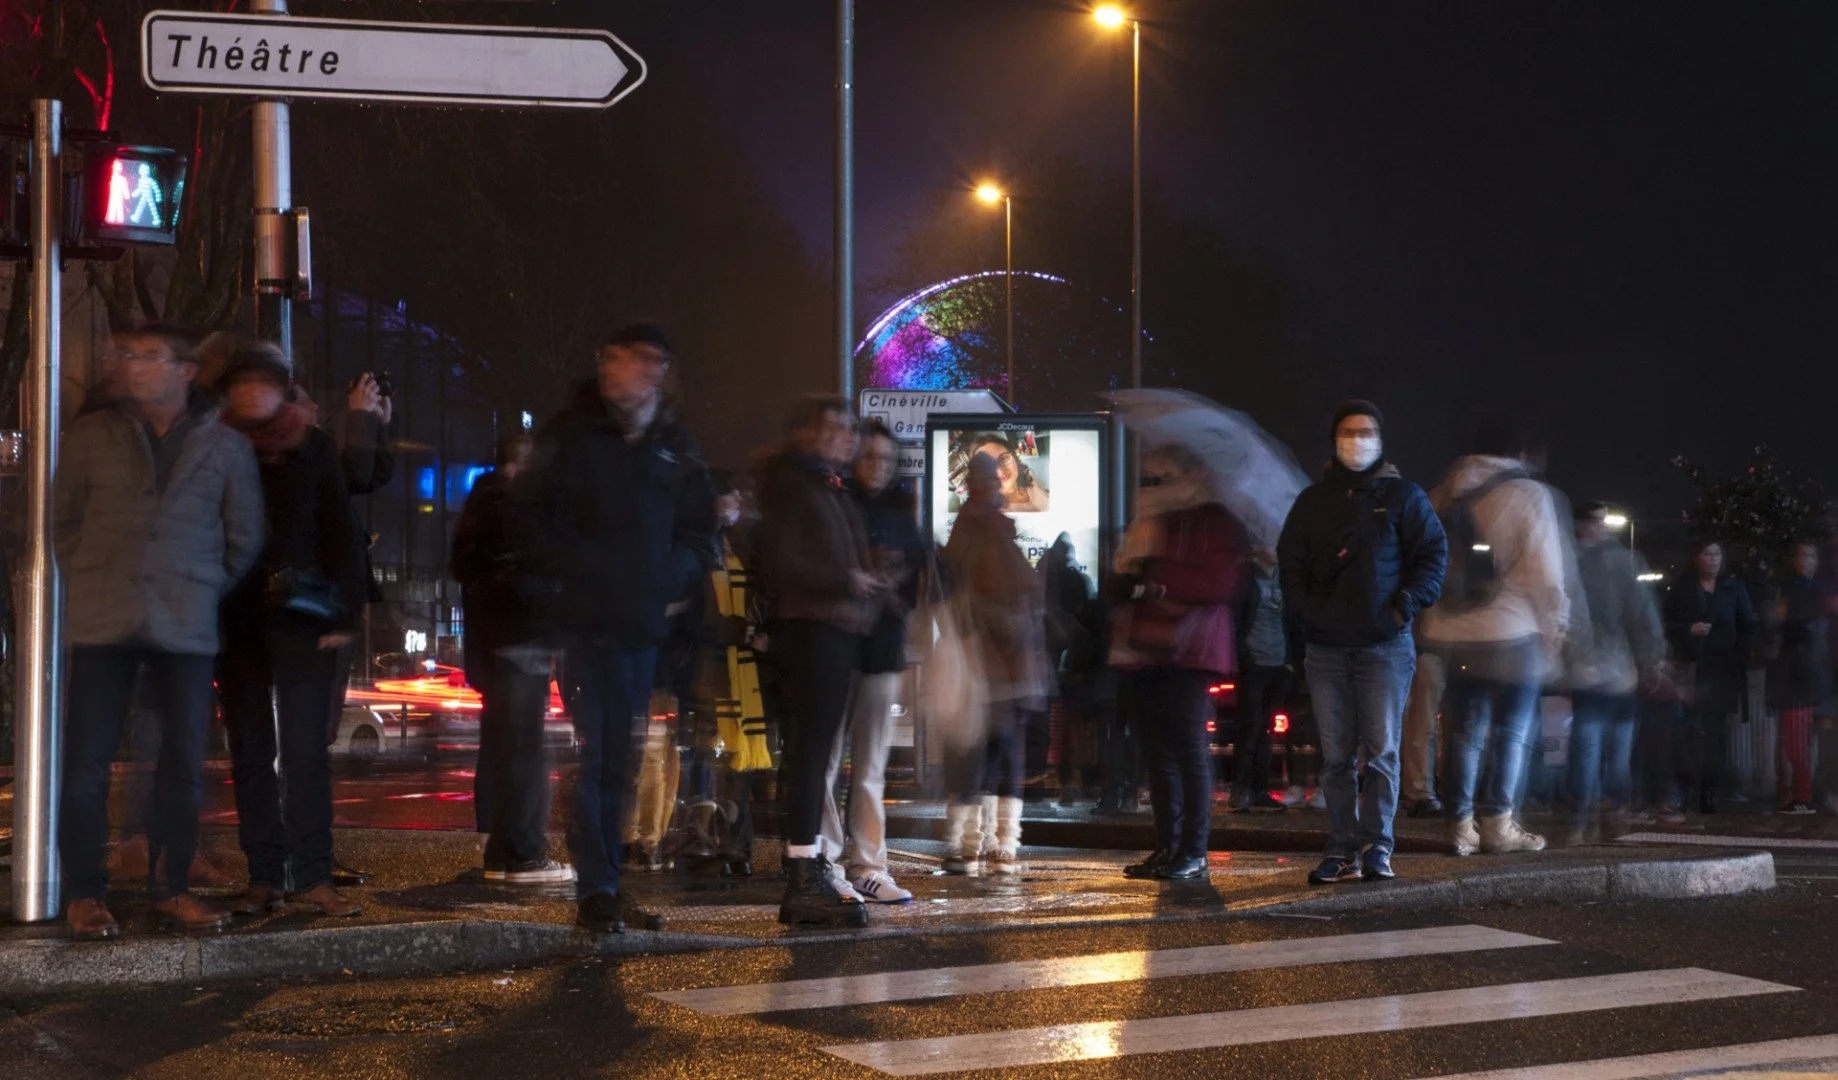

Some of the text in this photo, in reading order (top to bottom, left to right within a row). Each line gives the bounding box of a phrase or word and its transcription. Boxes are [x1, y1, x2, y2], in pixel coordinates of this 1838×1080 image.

[168, 34, 339, 75] Théâtre
[868, 394, 947, 408] Cinéville
[997, 423, 1035, 431] JCDecaux
